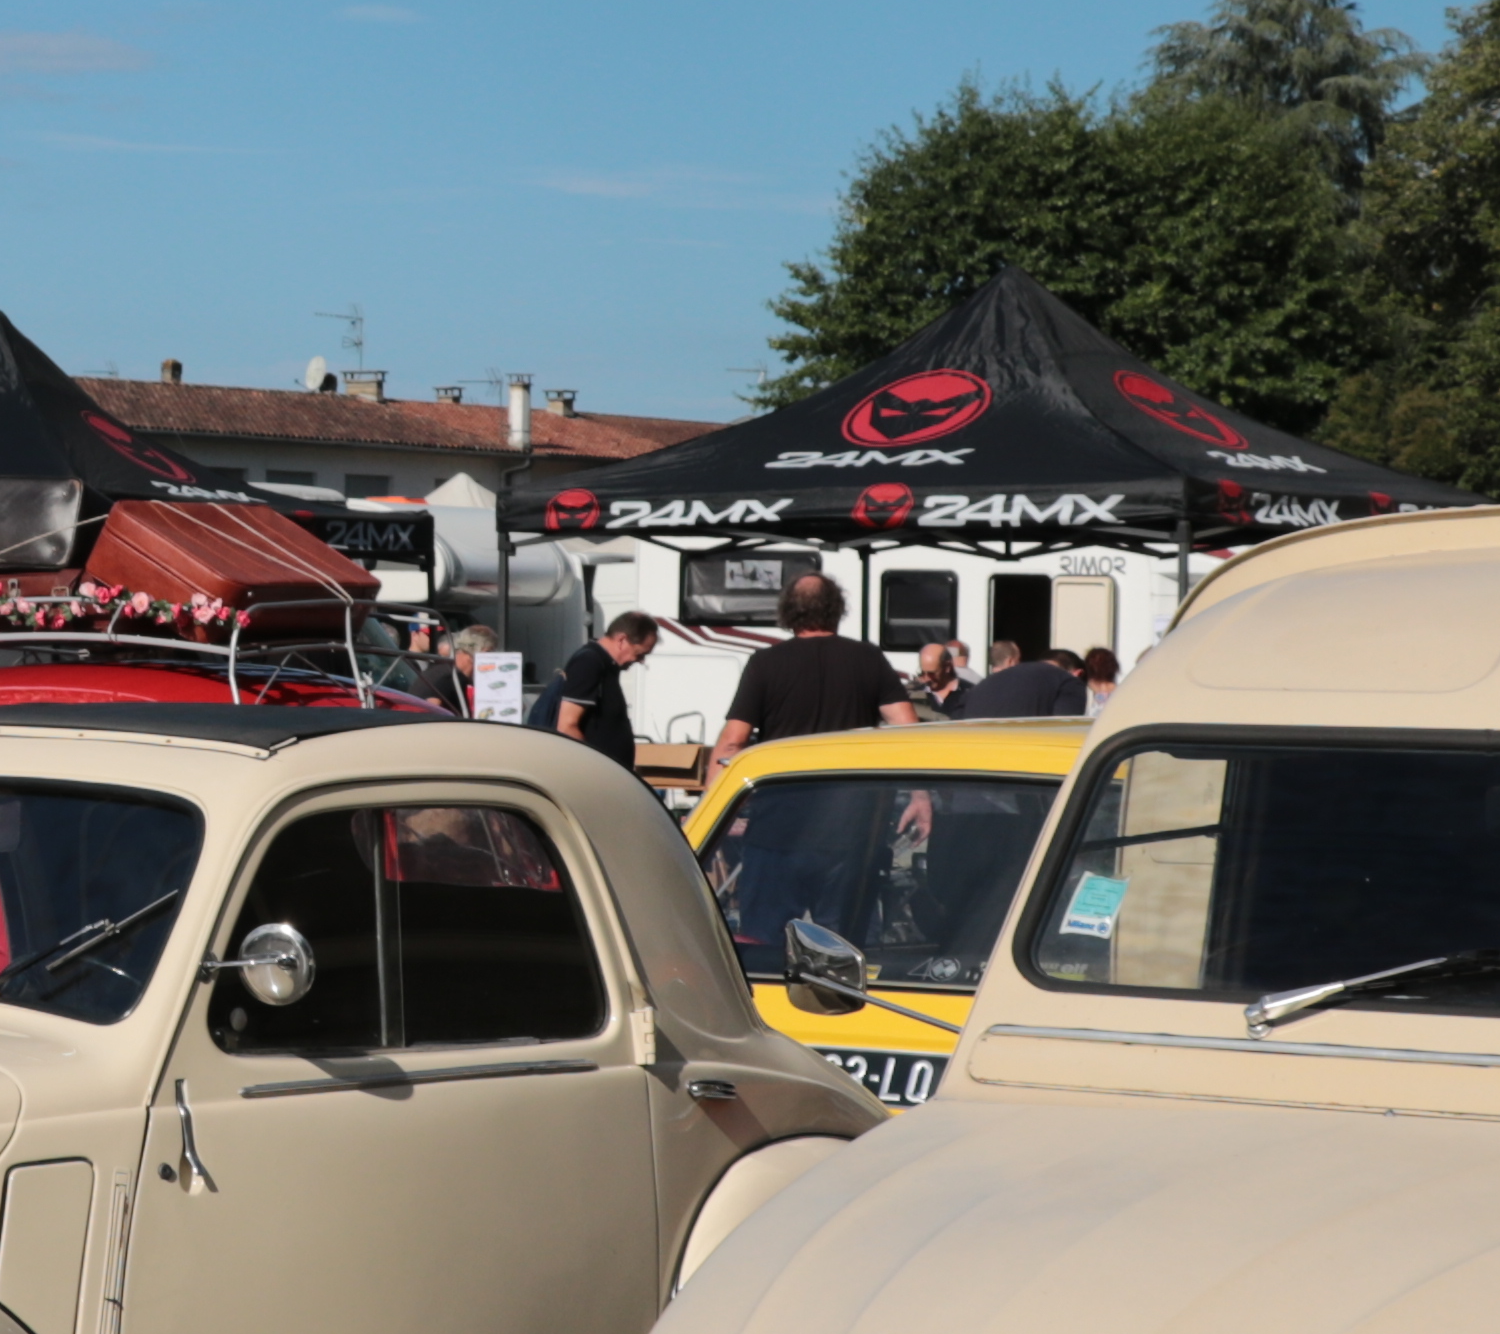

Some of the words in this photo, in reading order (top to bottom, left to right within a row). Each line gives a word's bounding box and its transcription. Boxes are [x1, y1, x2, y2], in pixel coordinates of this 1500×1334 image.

[765, 448, 976, 469] 24MX
[605, 498, 794, 529] 24MX
[917, 494, 1126, 528] 24MX
[1250, 492, 1344, 527] 24MX
[326, 521, 416, 551] 24MX
